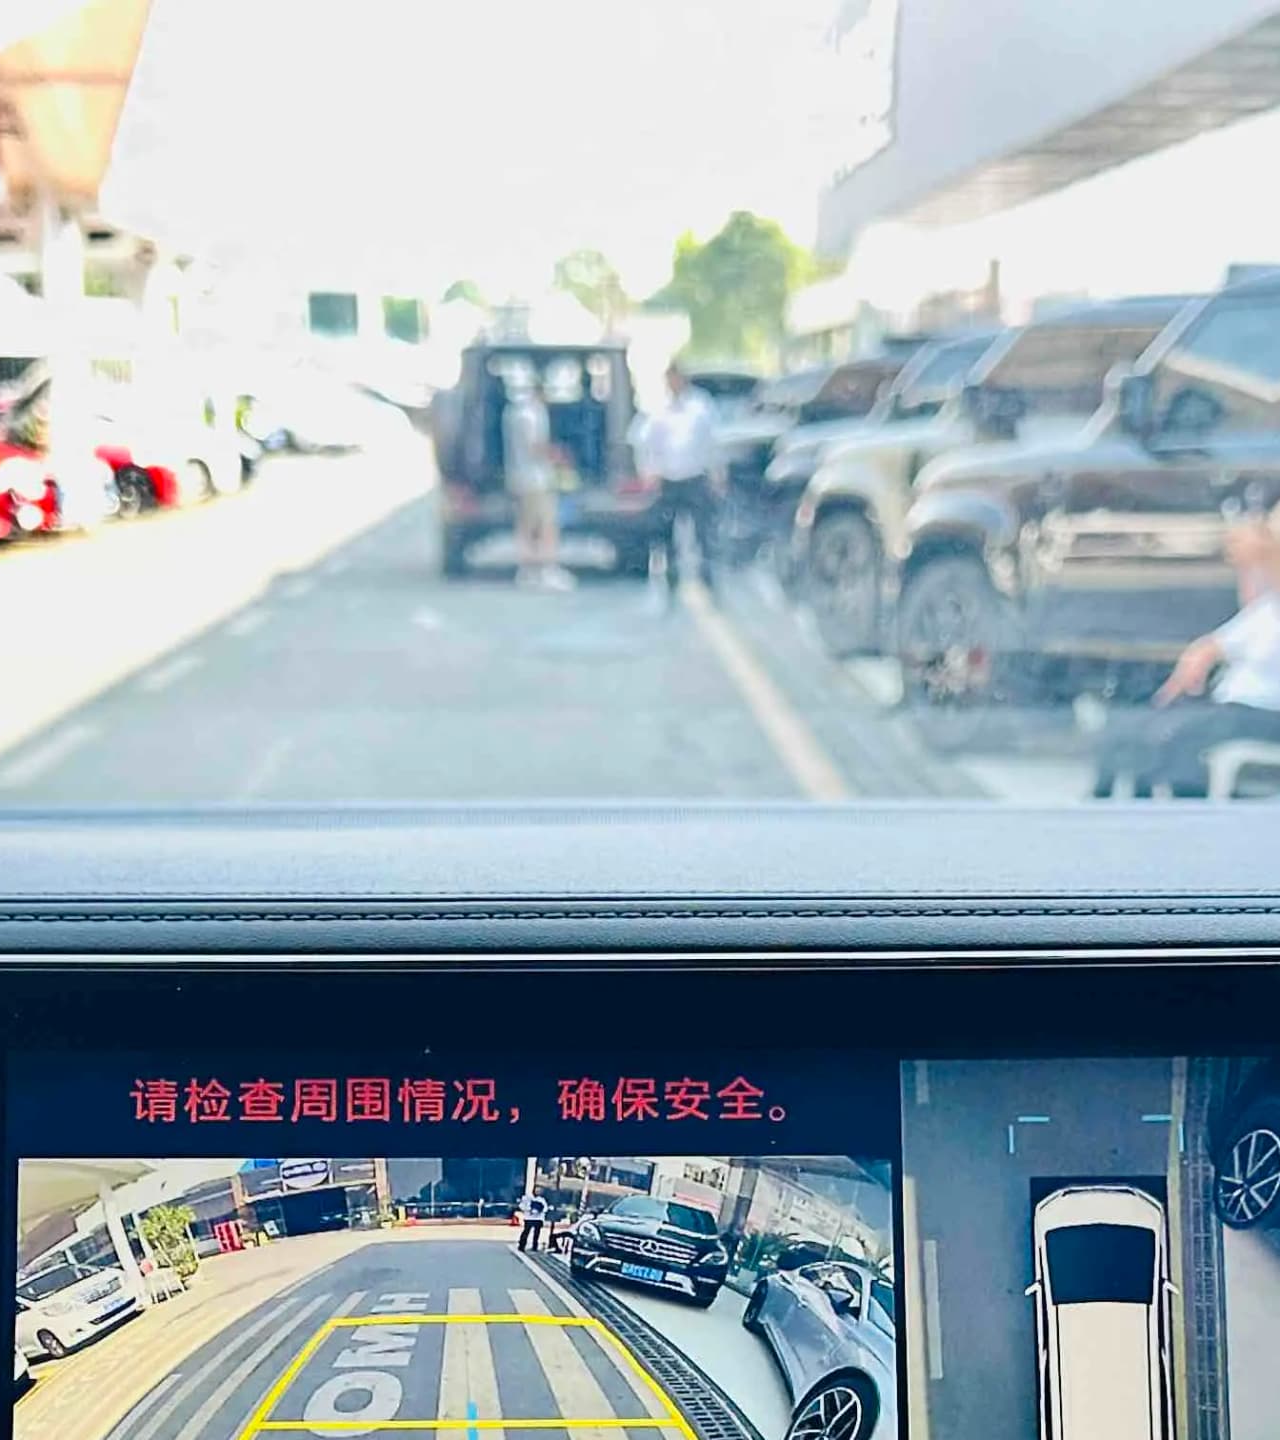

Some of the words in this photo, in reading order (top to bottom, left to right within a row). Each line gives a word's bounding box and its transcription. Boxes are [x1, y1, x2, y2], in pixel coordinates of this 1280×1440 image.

[129, 1077, 787, 1123] 请检查周围情况，确保安全。
